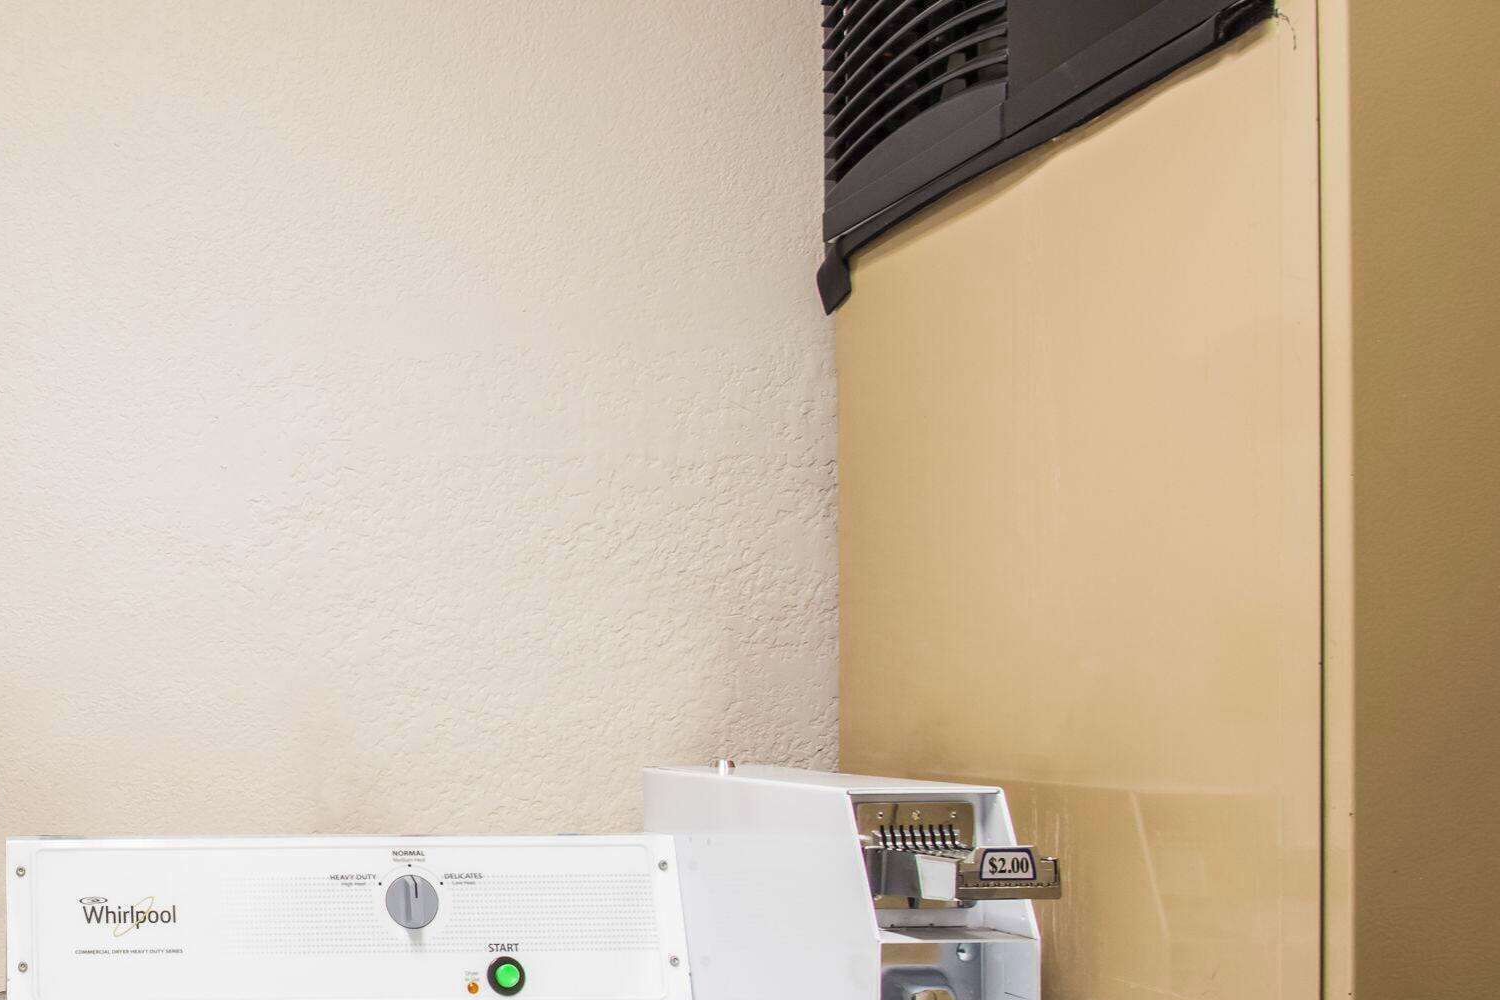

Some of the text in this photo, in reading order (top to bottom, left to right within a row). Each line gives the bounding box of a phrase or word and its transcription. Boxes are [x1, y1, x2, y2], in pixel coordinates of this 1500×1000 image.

[988, 857, 1030, 875] $2.00
[82, 905, 177, 929] Whirlpool
[488, 943, 519, 952] START
